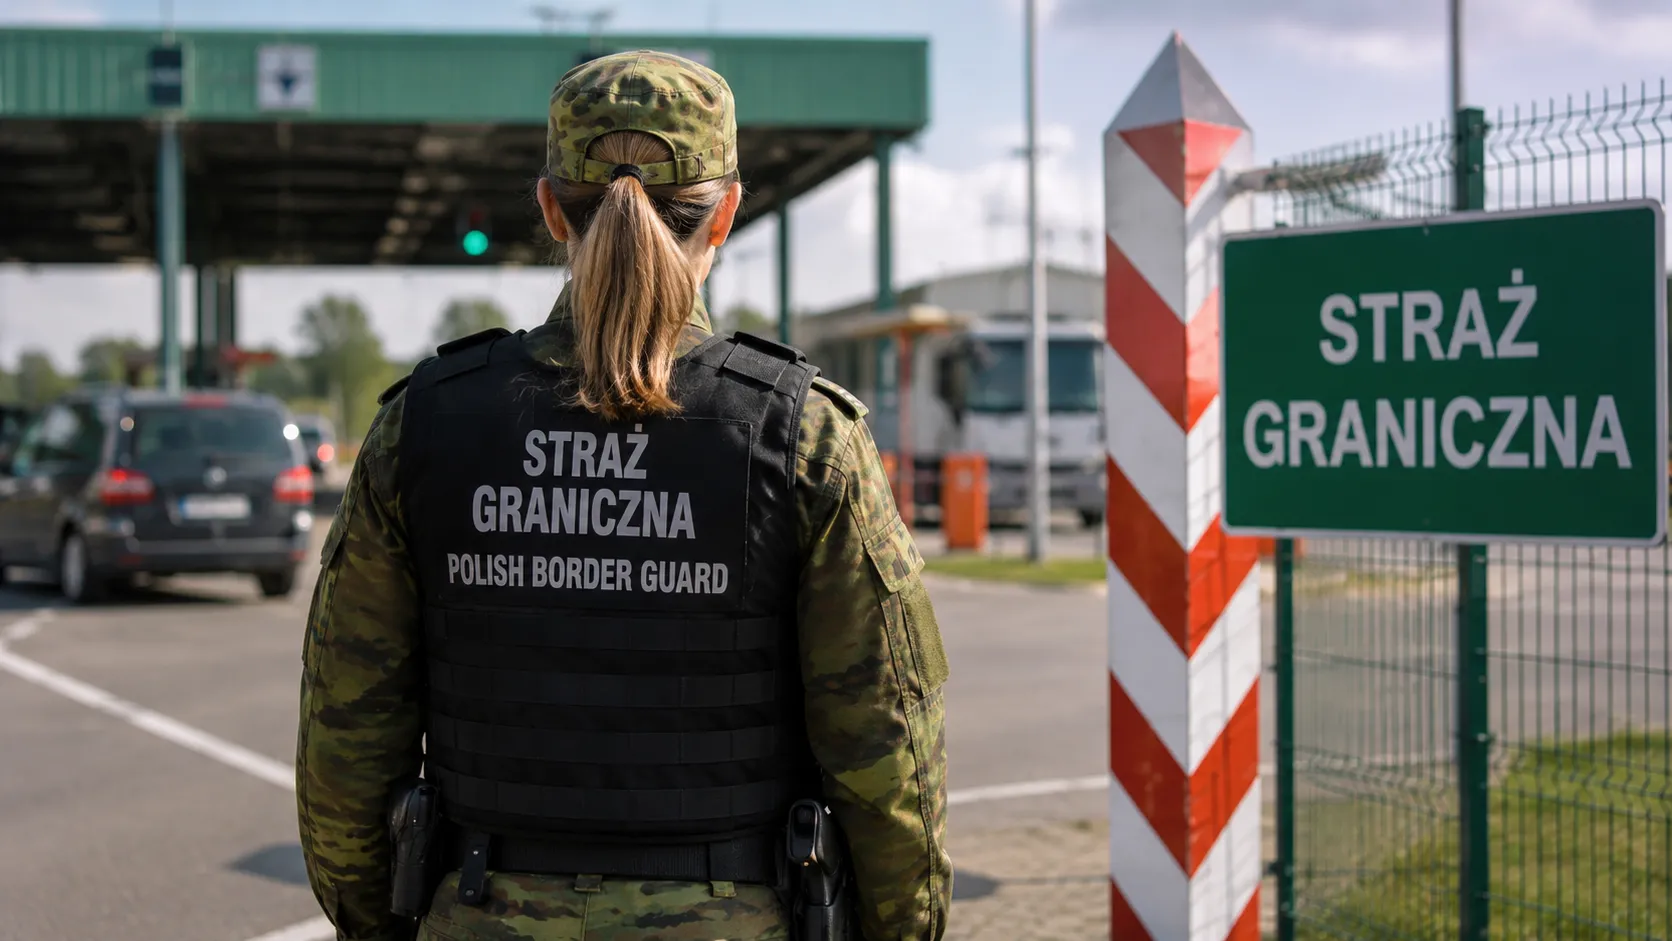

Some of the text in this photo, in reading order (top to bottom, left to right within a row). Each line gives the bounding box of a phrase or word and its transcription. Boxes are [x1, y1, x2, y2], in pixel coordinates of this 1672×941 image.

[1319, 268, 1539, 365] STRAŻ
[523, 423, 649, 479] STRAŻ
[1243, 395, 1632, 469] GRANICZNA
[472, 484, 696, 539] GRANICZNA
[447, 553, 729, 594] POLISH BORDER GUARD
